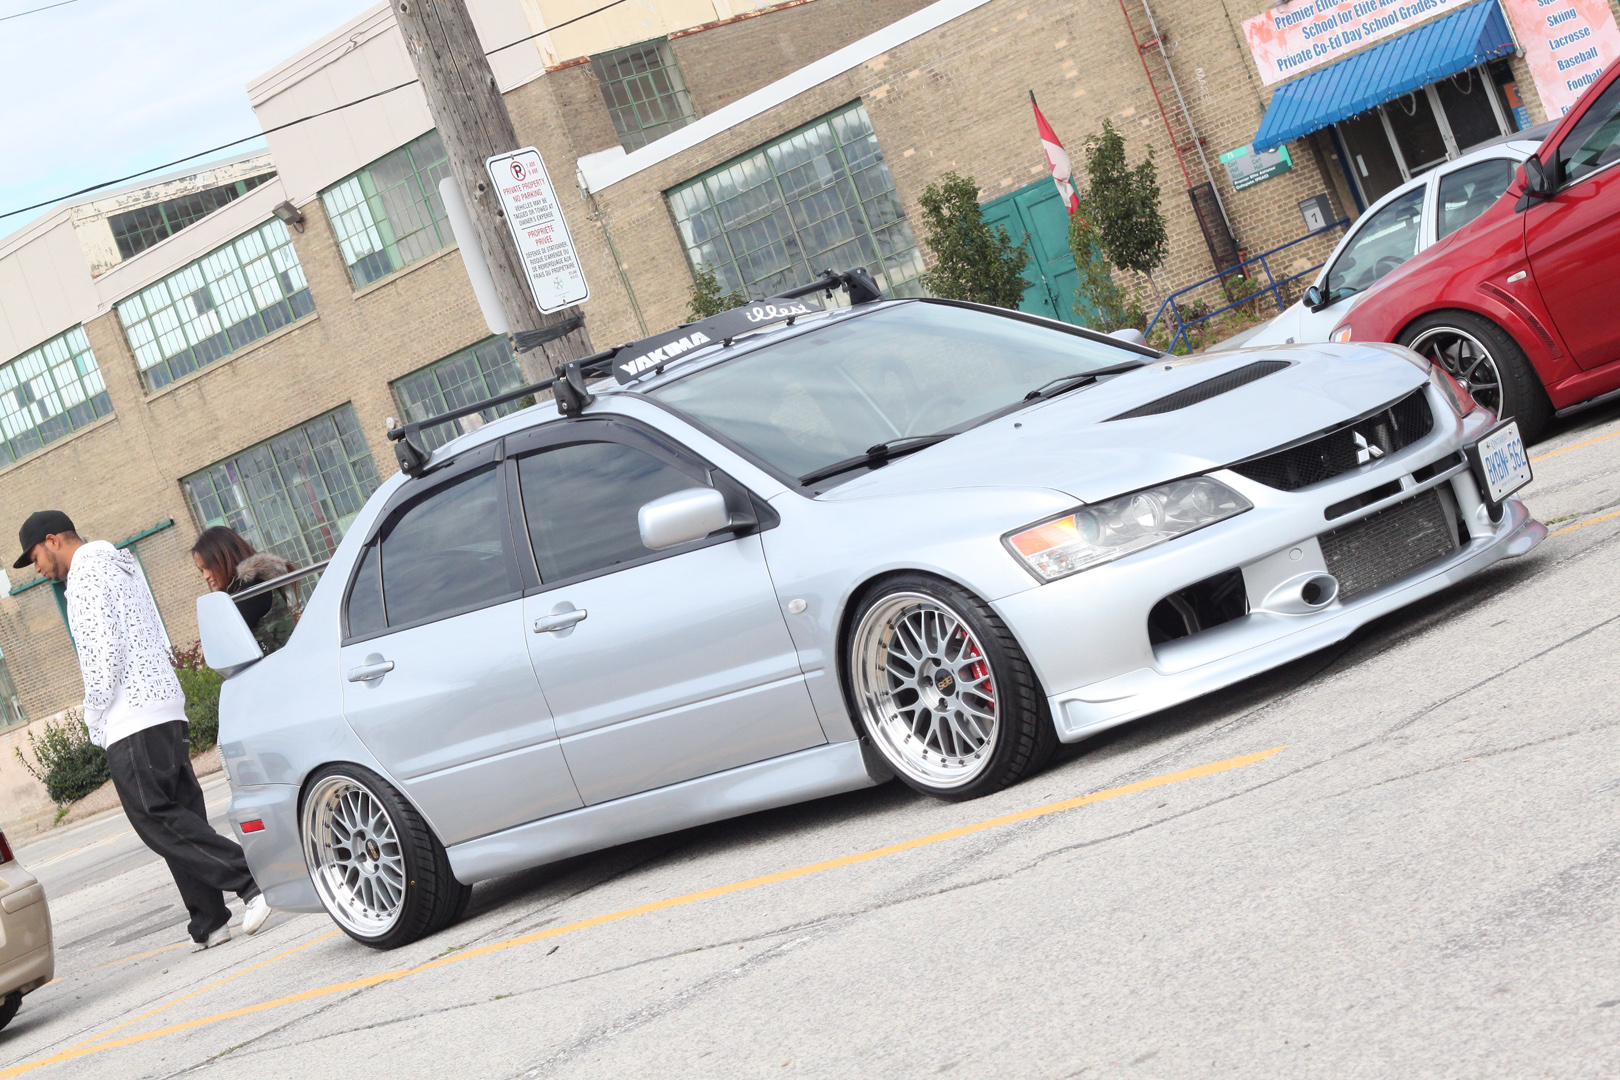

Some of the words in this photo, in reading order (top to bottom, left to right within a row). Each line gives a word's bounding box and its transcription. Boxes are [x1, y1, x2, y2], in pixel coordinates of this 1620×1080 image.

[1274, 4, 1315, 30] Premier
[1302, 14, 1338, 40] School
[1338, 9, 1353, 24] for
[1353, 0, 1377, 18] Elite
[1546, 8, 1577, 27] Skiing
[1277, 48, 1313, 72] Private
[1312, 34, 1342, 56] Co-Ed
[1342, 28, 1362, 44] Day
[1362, 10, 1399, 36] School
[1398, 0, 1437, 20] Grades
[1549, 27, 1590, 50] Lacrosse
[1557, 46, 1598, 71] Baseball
[503, 184, 522, 196] PRIVATE
[522, 178, 546, 190] PROPERTY
[521, 188, 543, 200] PARKING
[513, 210, 528, 219] TAGGED
[535, 205, 548, 214] TOWED
[514, 202, 533, 211] VEHICLES
[537, 211, 554, 221] EXPENSE
[1311, 212, 1318, 223] 7
[746, 303, 812, 322] illest
[620, 332, 711, 376] YAKIMA
[1507, 438, 1526, 470] 562
